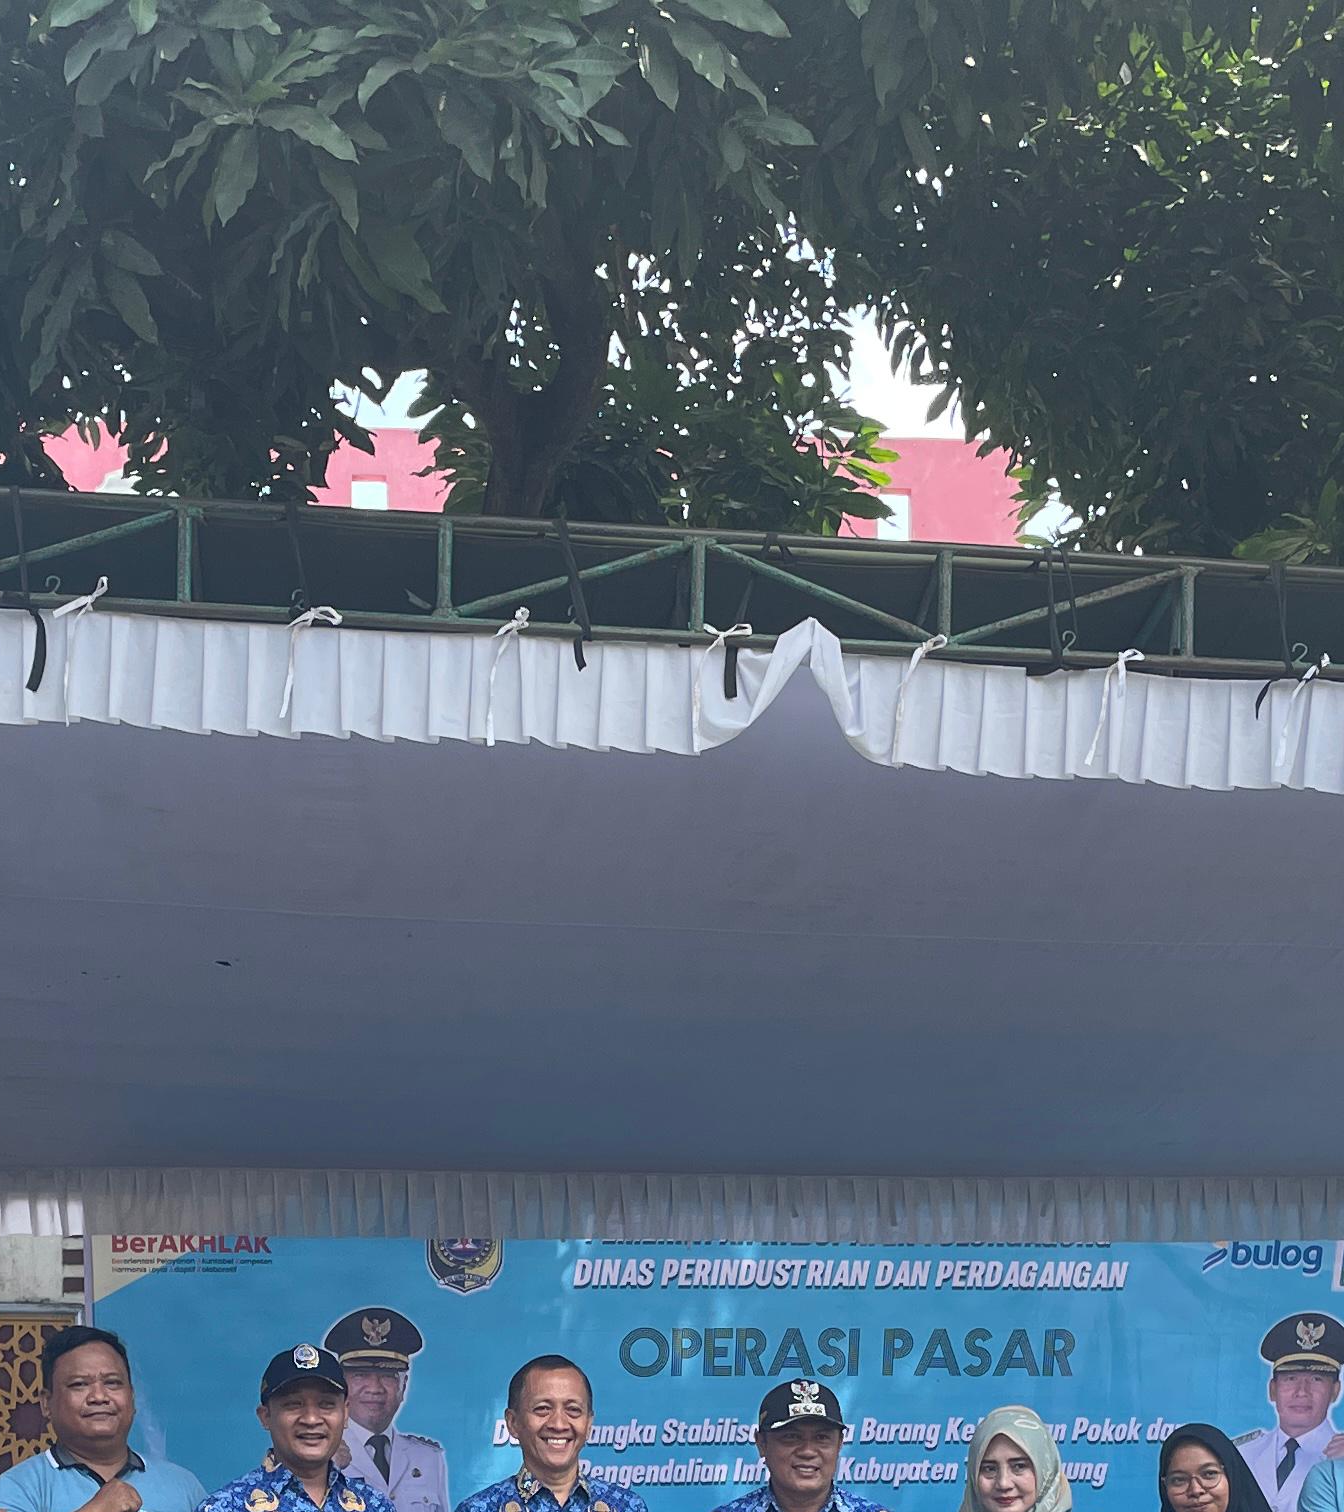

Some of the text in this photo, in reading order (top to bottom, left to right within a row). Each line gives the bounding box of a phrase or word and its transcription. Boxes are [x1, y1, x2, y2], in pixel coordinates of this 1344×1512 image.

[112, 1235, 272, 1254] BerAKHLAK
[1231, 1241, 1323, 1274] bulog
[573, 1258, 1129, 1291] DINAS PERINDUSTRIAN DAN PERDAGANGAN
[618, 1327, 1076, 1377] OPERASI PASAR
[586, 1418, 657, 1450] angka
[860, 1417, 942, 1449] Barang
[1071, 1416, 1143, 1445] Pokok
[579, 1458, 727, 1489] Pengendalian
[837, 1456, 959, 1490] Kabupaten
